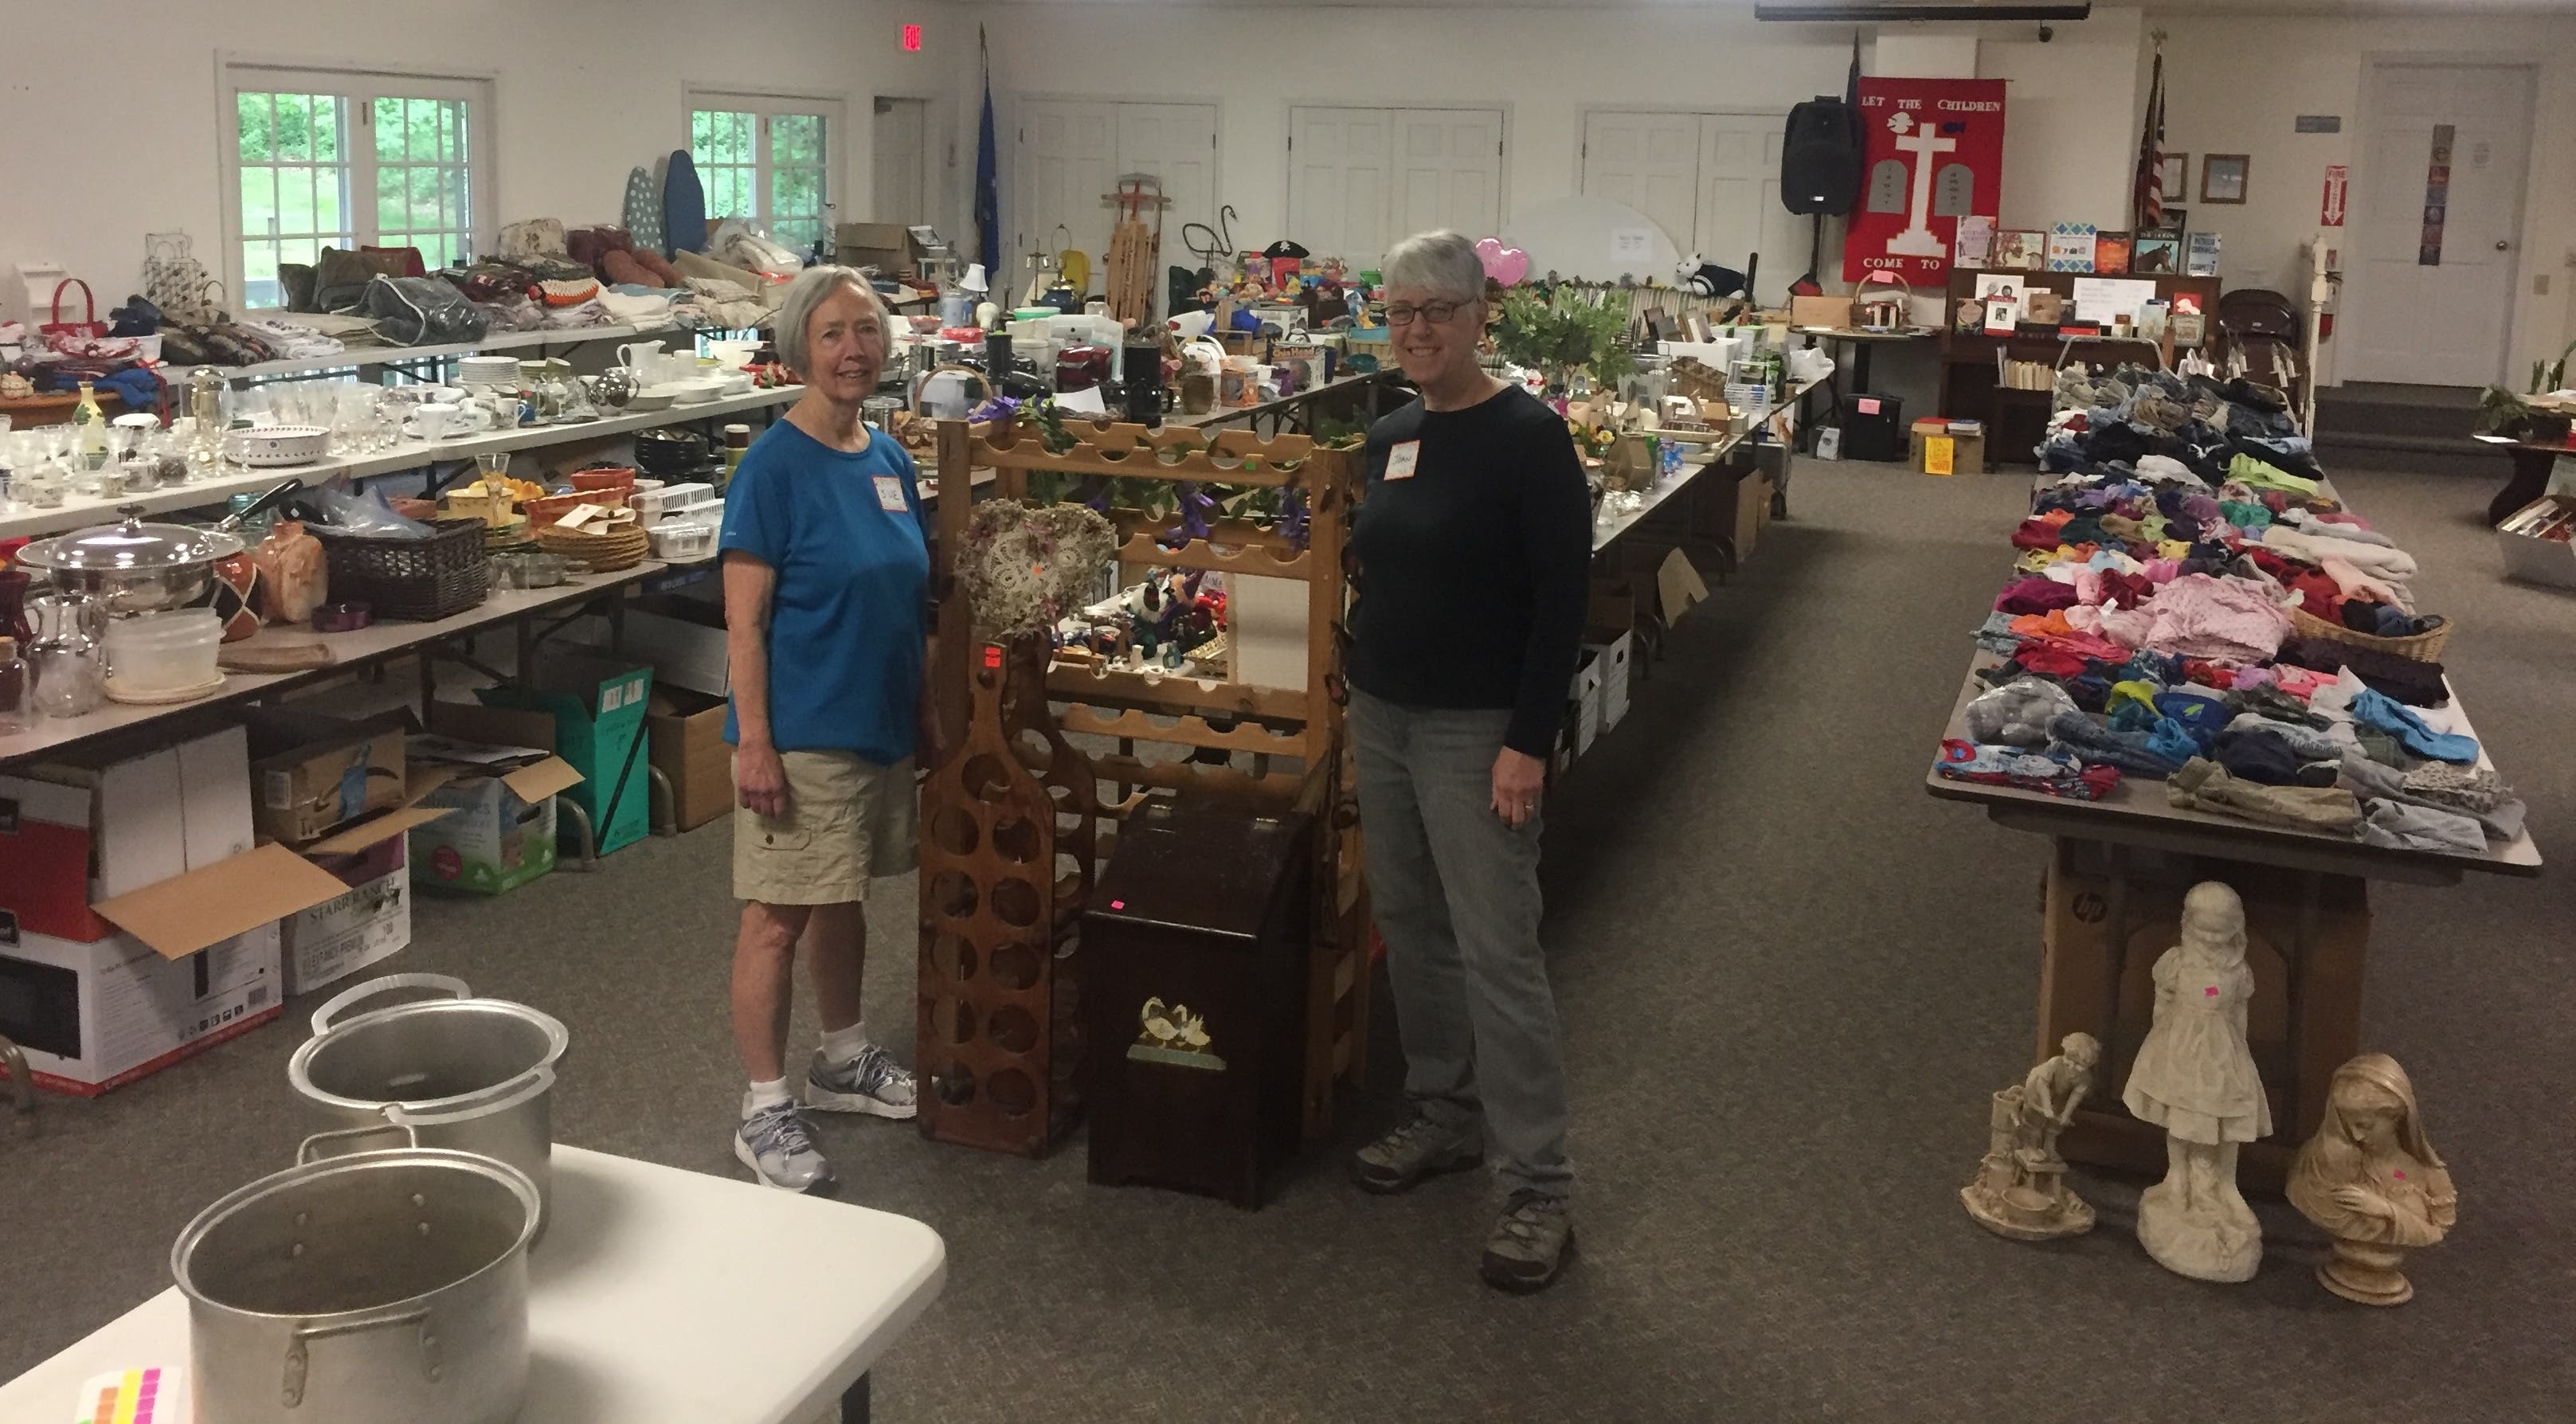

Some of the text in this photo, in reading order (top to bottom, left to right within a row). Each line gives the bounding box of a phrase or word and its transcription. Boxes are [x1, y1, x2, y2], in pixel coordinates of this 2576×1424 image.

[1861, 96, 2002, 112] LET THE CHILDREN
[2327, 170, 2346, 178] FIRE
[1862, 257, 1940, 270] COME TO
[880, 489, 900, 501] SUE
[309, 896, 350, 924] STARR
[2076, 893, 2104, 924] hp
